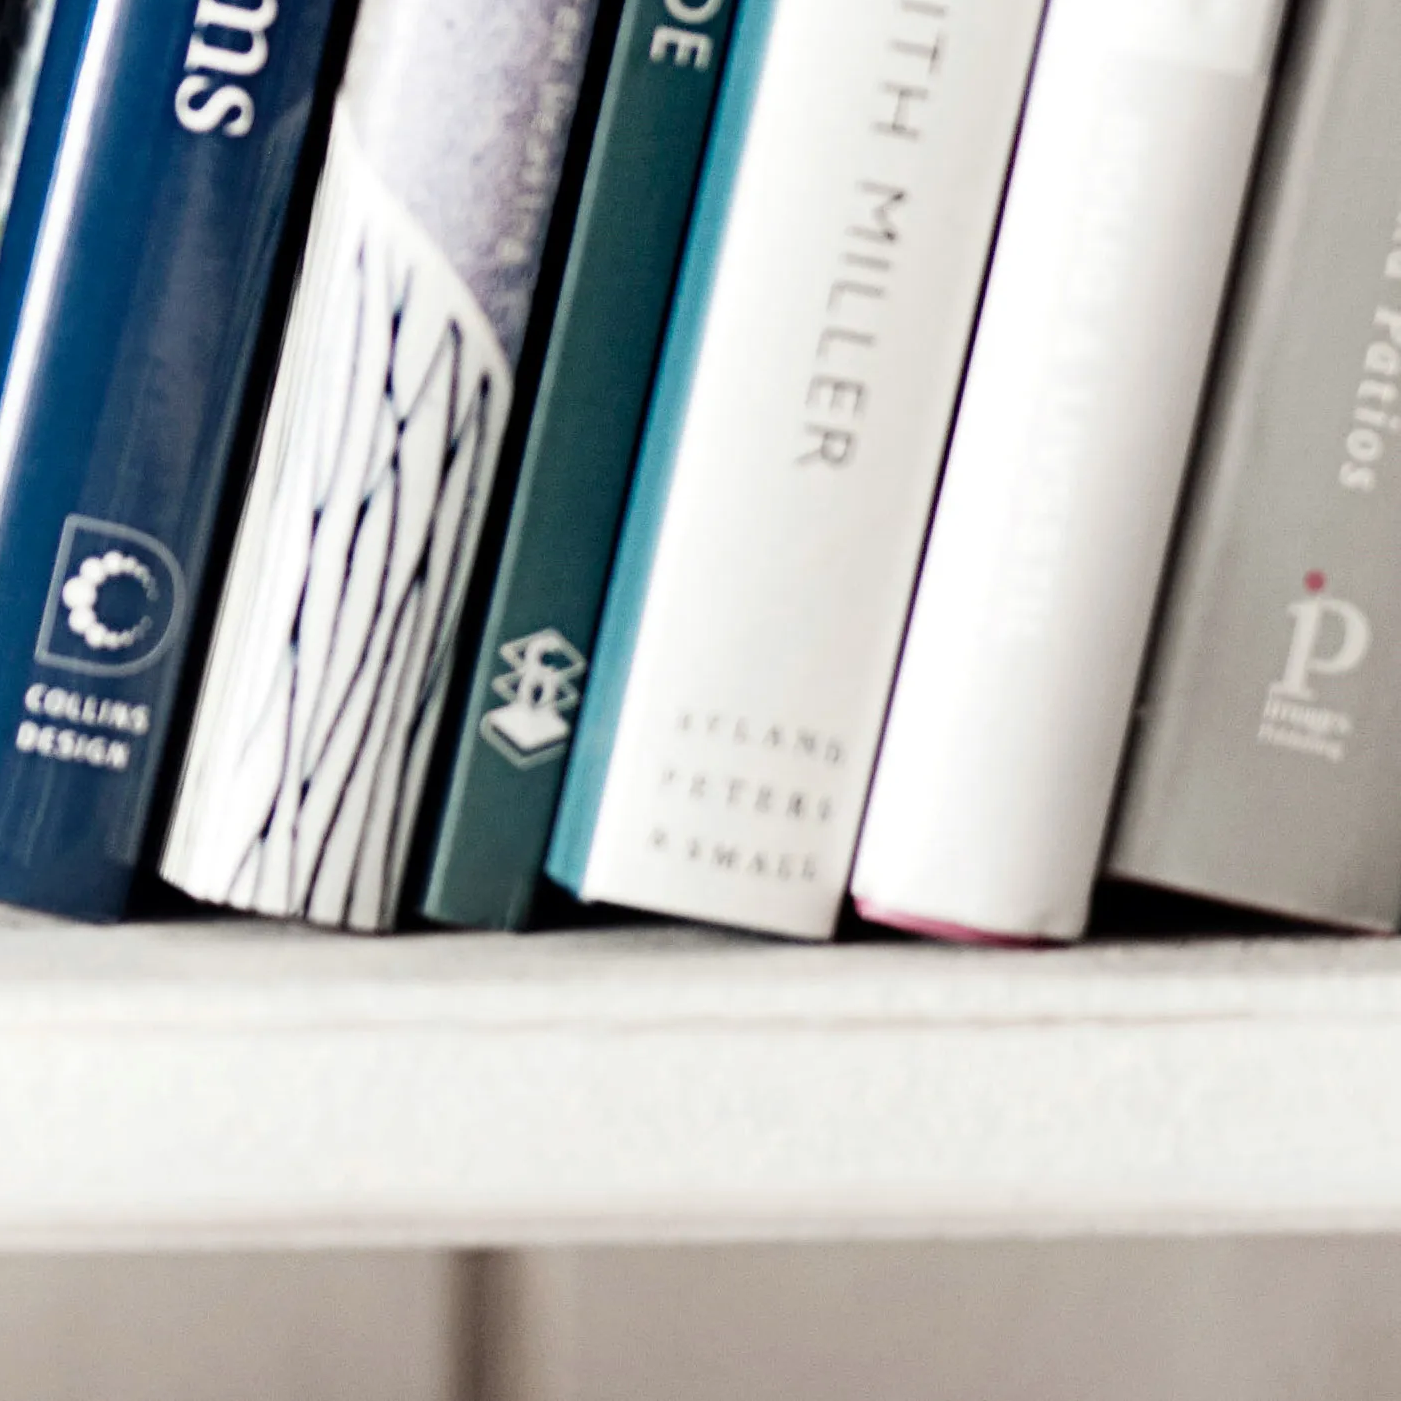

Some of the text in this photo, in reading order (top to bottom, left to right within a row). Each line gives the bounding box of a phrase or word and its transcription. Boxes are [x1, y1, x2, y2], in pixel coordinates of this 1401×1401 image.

[792, 176, 909, 469] MILLER
[25, 682, 151, 737] COLLINS
[16, 719, 131, 773] DESIGN
